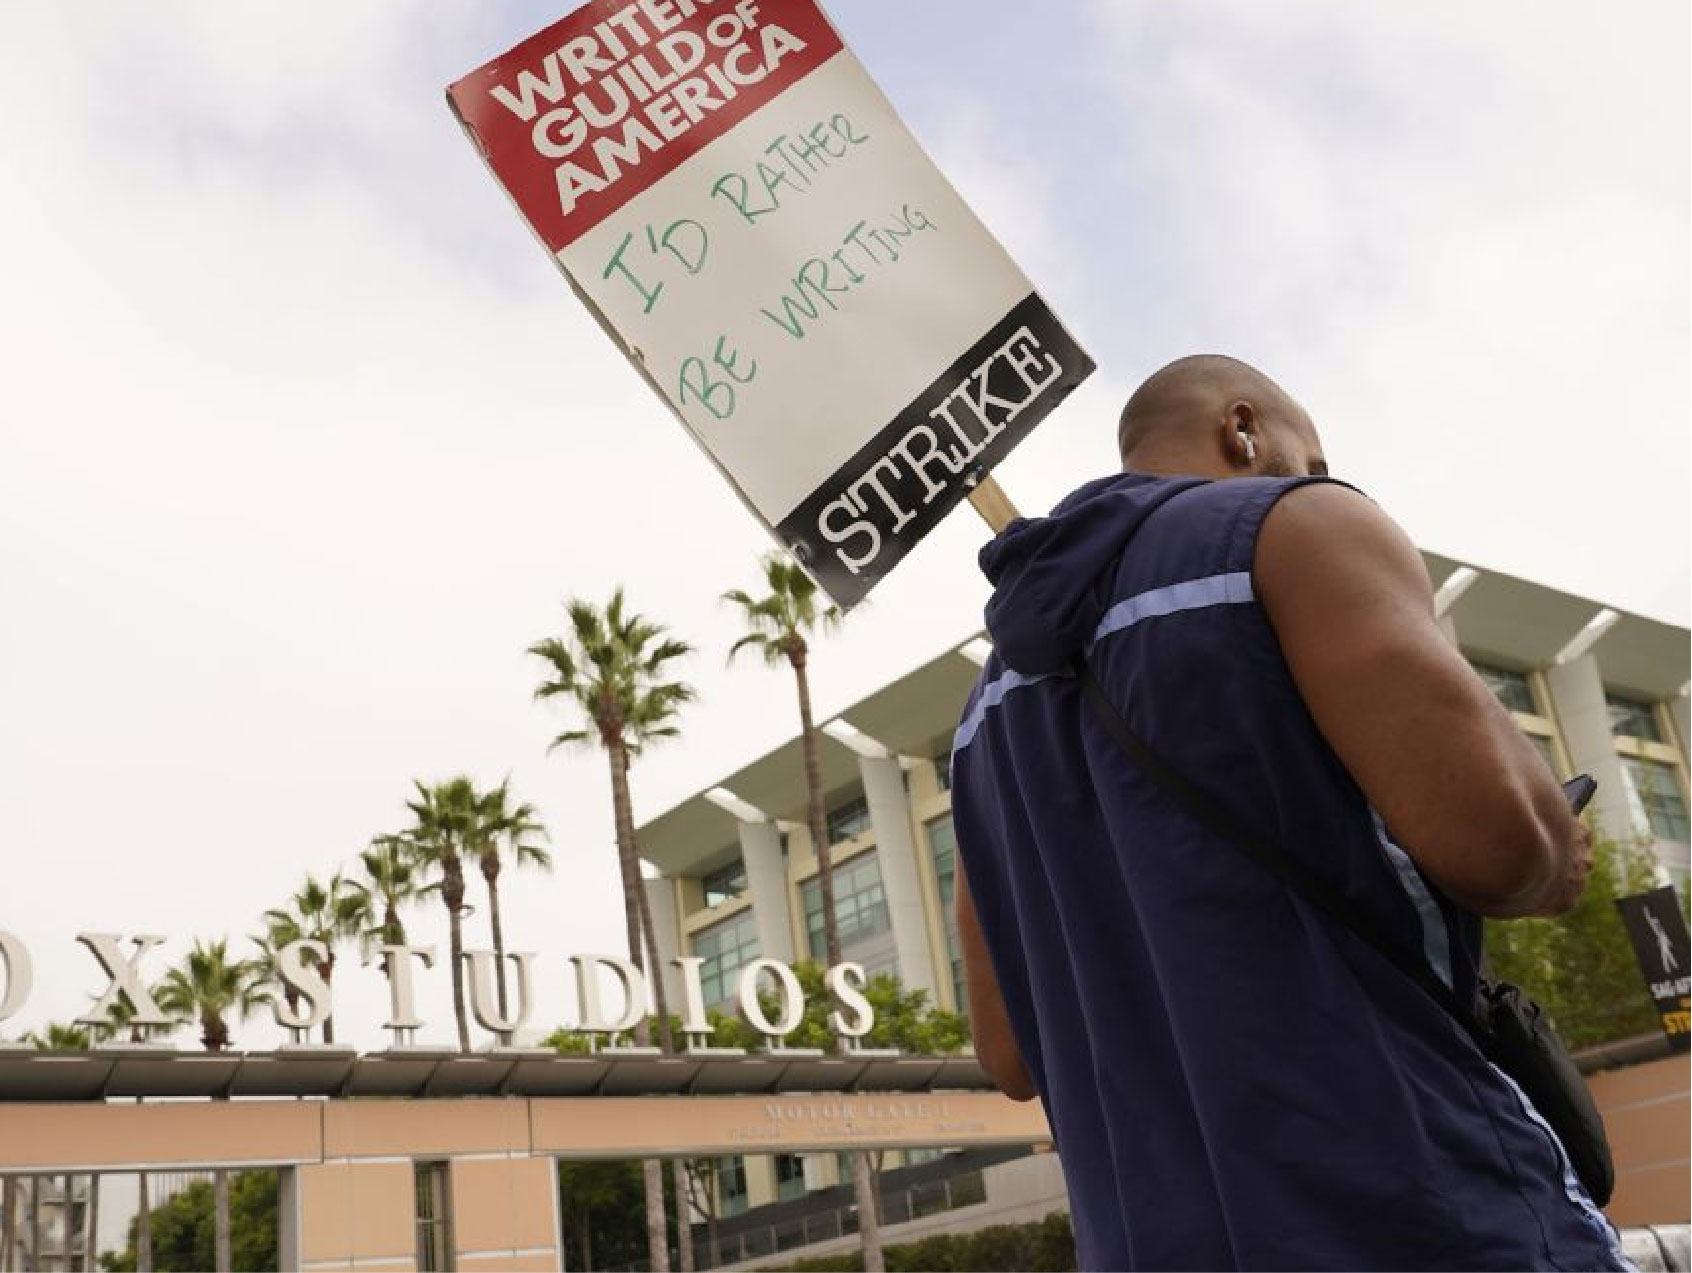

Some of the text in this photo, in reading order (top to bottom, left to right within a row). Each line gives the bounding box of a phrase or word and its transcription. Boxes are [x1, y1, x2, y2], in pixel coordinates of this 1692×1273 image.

[532, 0, 760, 158] GUILD OF
[555, 23, 808, 216] AMERICA
[603, 113, 870, 314] I'D RATHER
[679, 204, 937, 419] BE WRITING
[818, 325, 1063, 575] STRIKE
[270, 938, 876, 1038] STUDIOS
[764, 1102, 857, 1119] MOTOR
